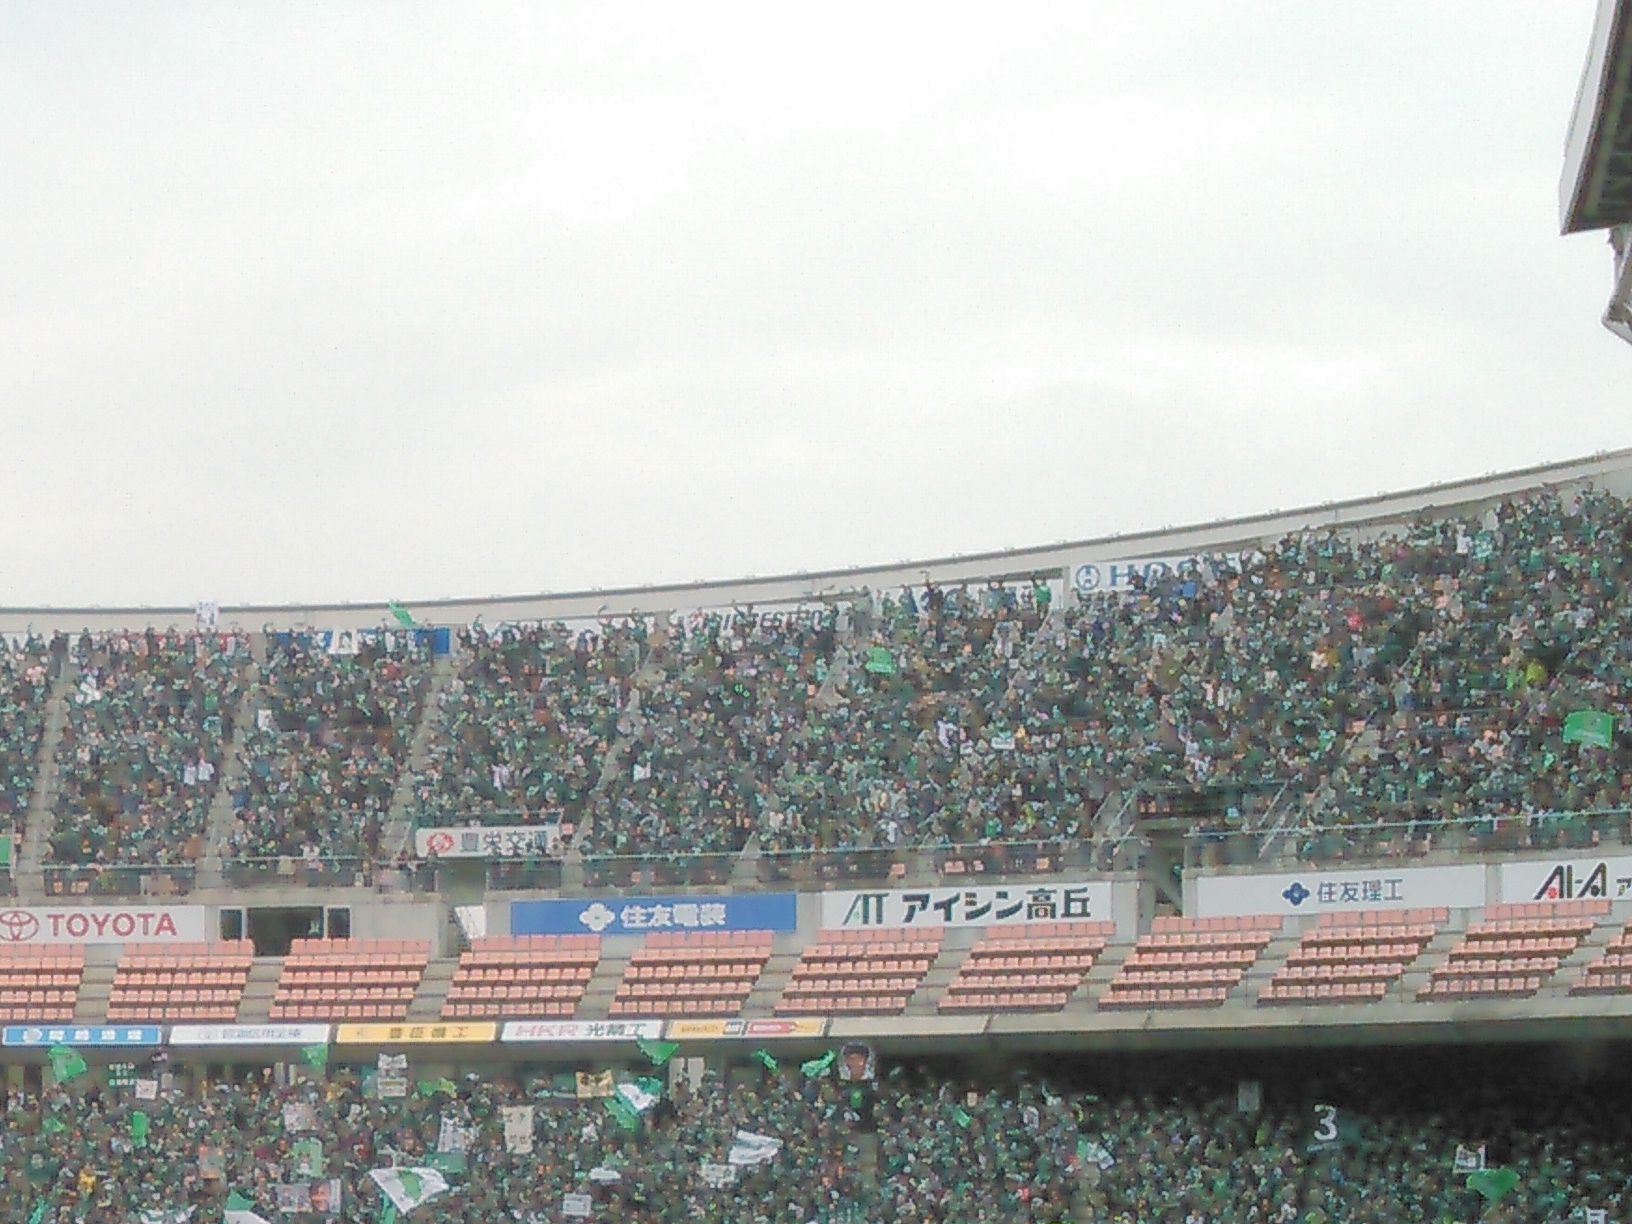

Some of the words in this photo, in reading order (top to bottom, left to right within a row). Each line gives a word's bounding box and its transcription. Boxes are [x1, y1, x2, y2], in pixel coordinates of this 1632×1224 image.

[1316, 878, 1404, 904] 住友理工
[620, 903, 727, 928] 住友電装
[901, 886, 1091, 924] アイシン高丘
[47, 912, 178, 937] TOYOTA
